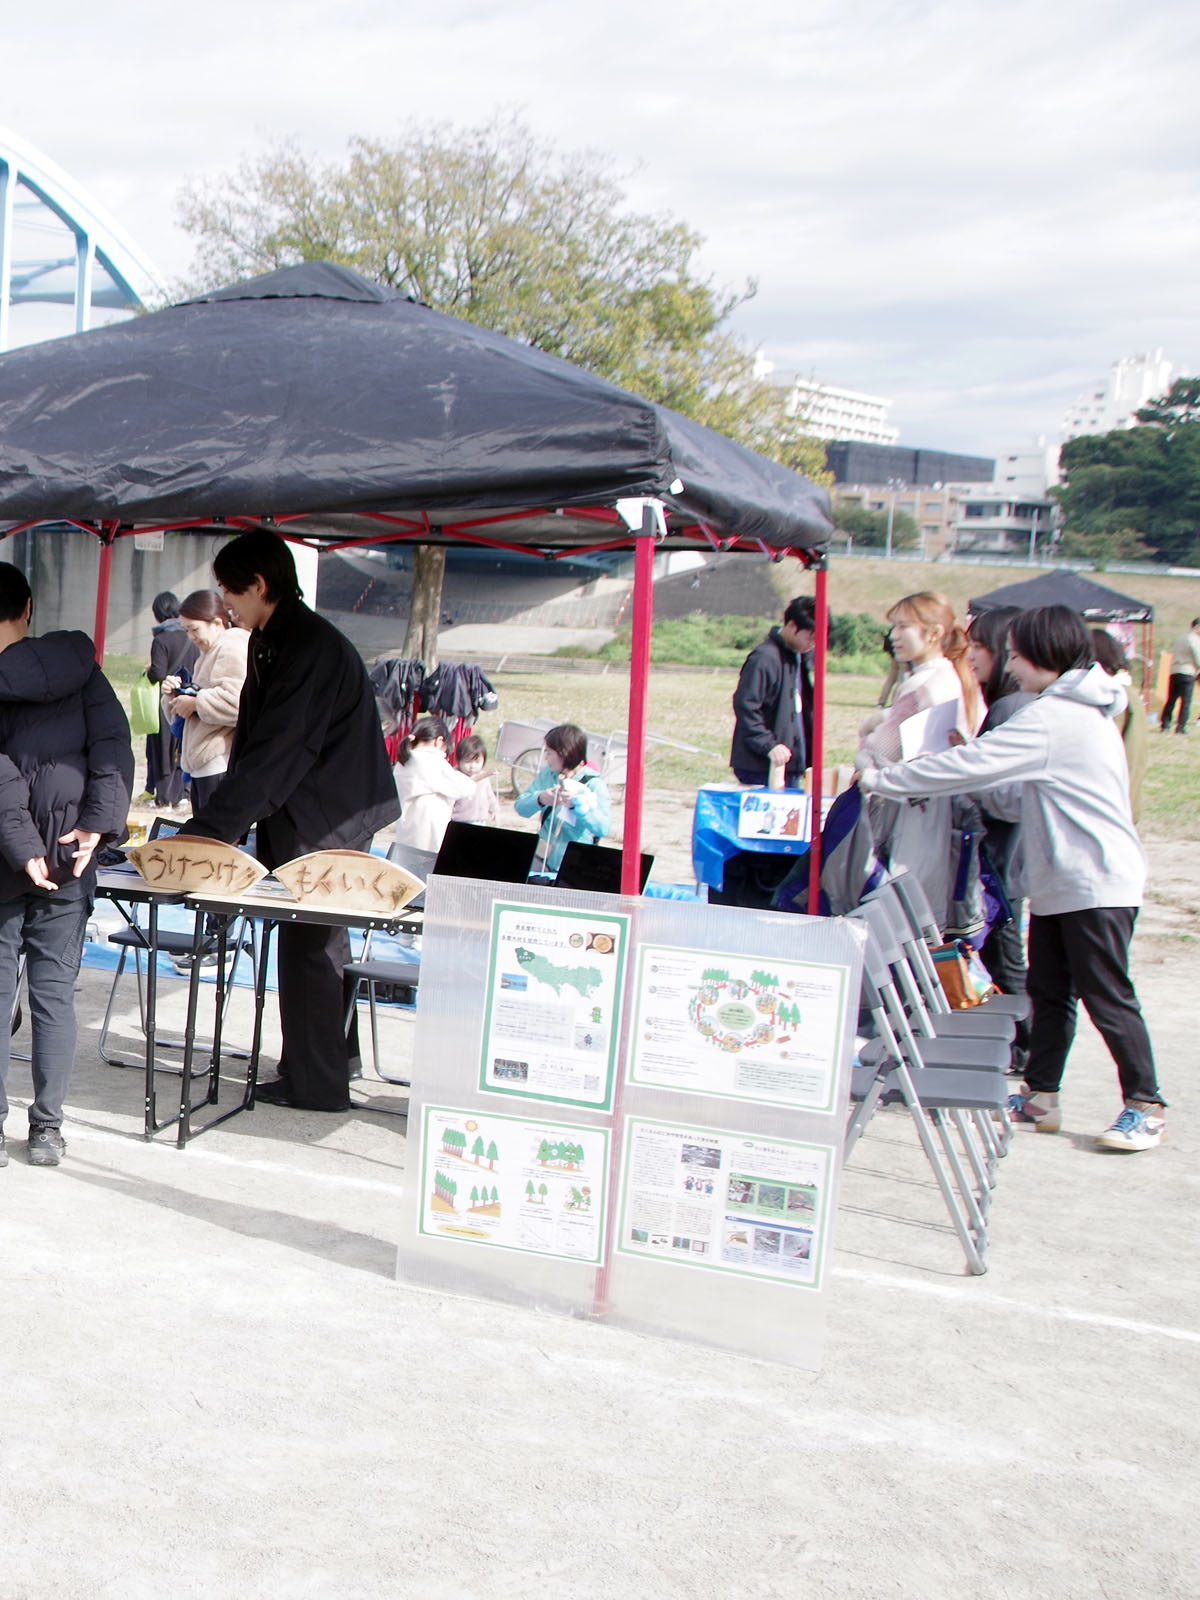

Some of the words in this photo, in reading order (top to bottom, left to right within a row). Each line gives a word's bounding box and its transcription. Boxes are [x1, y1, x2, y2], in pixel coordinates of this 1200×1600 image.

[148, 848, 239, 884] うけつけ
[296, 862, 388, 898] もくいく
